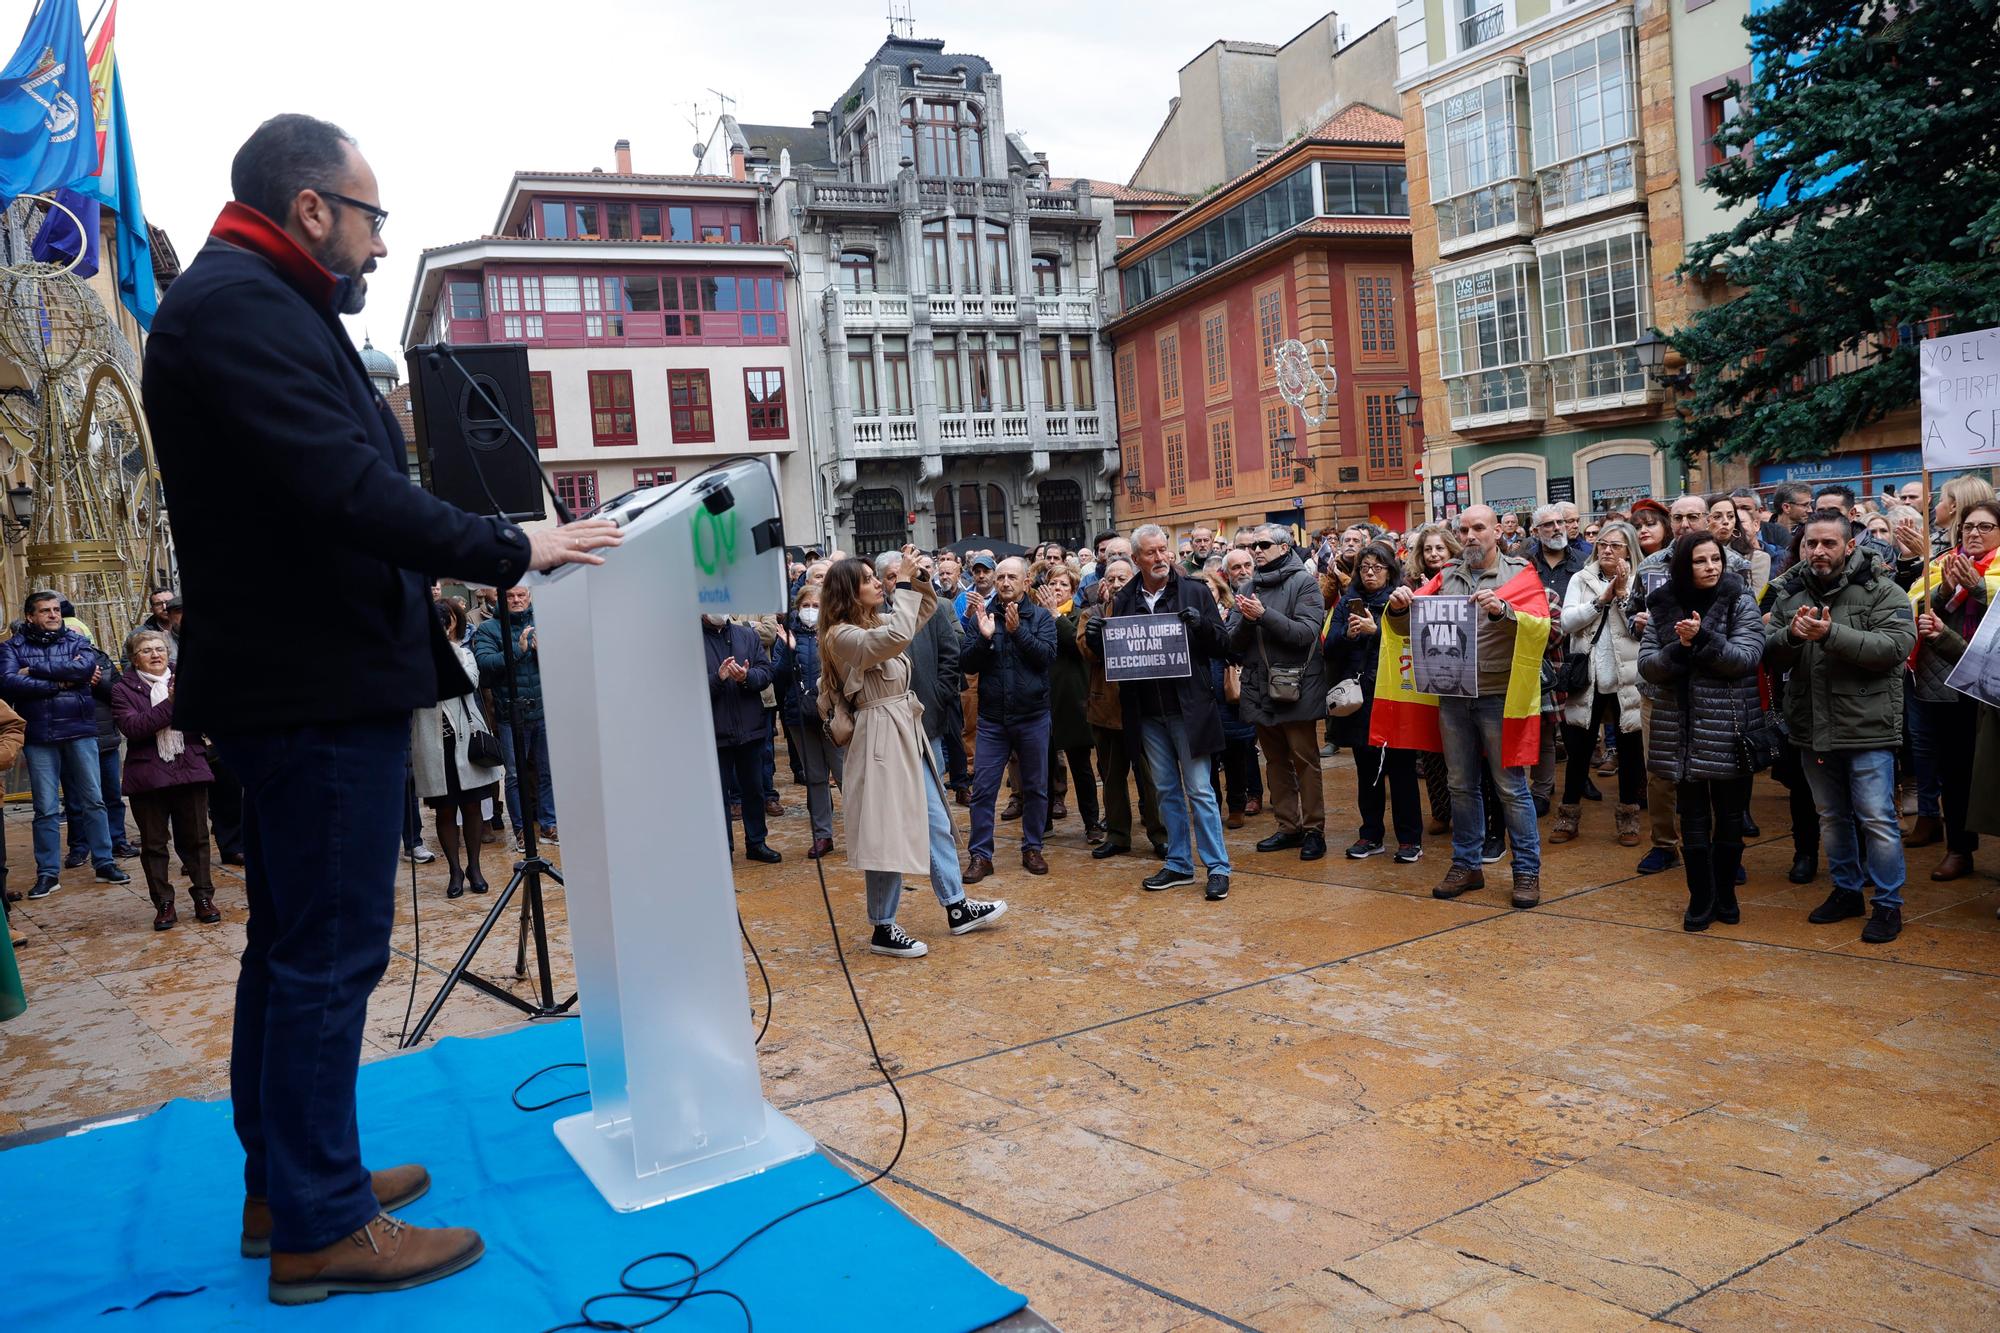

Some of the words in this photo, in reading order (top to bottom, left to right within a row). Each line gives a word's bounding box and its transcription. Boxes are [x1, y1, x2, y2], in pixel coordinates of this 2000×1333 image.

[1458, 277, 1473, 290] Yo
[1475, 272, 1491, 282] LOFT
[1476, 280, 1491, 288] CITY
[1476, 287, 1493, 295] HALL
[1926, 345, 1952, 368] YO
[1961, 339, 1985, 363] EL
[1925, 419, 1947, 450] A
[1418, 600, 1468, 624] ¡VETE
[1148, 623, 1183, 638] QUIERE
[1427, 624, 1457, 646] YA!
[1127, 638, 1163, 652] VOTAR!
[1106, 653, 1167, 669] ¡ELECCIONES
[1168, 651, 1188, 665] YA!
